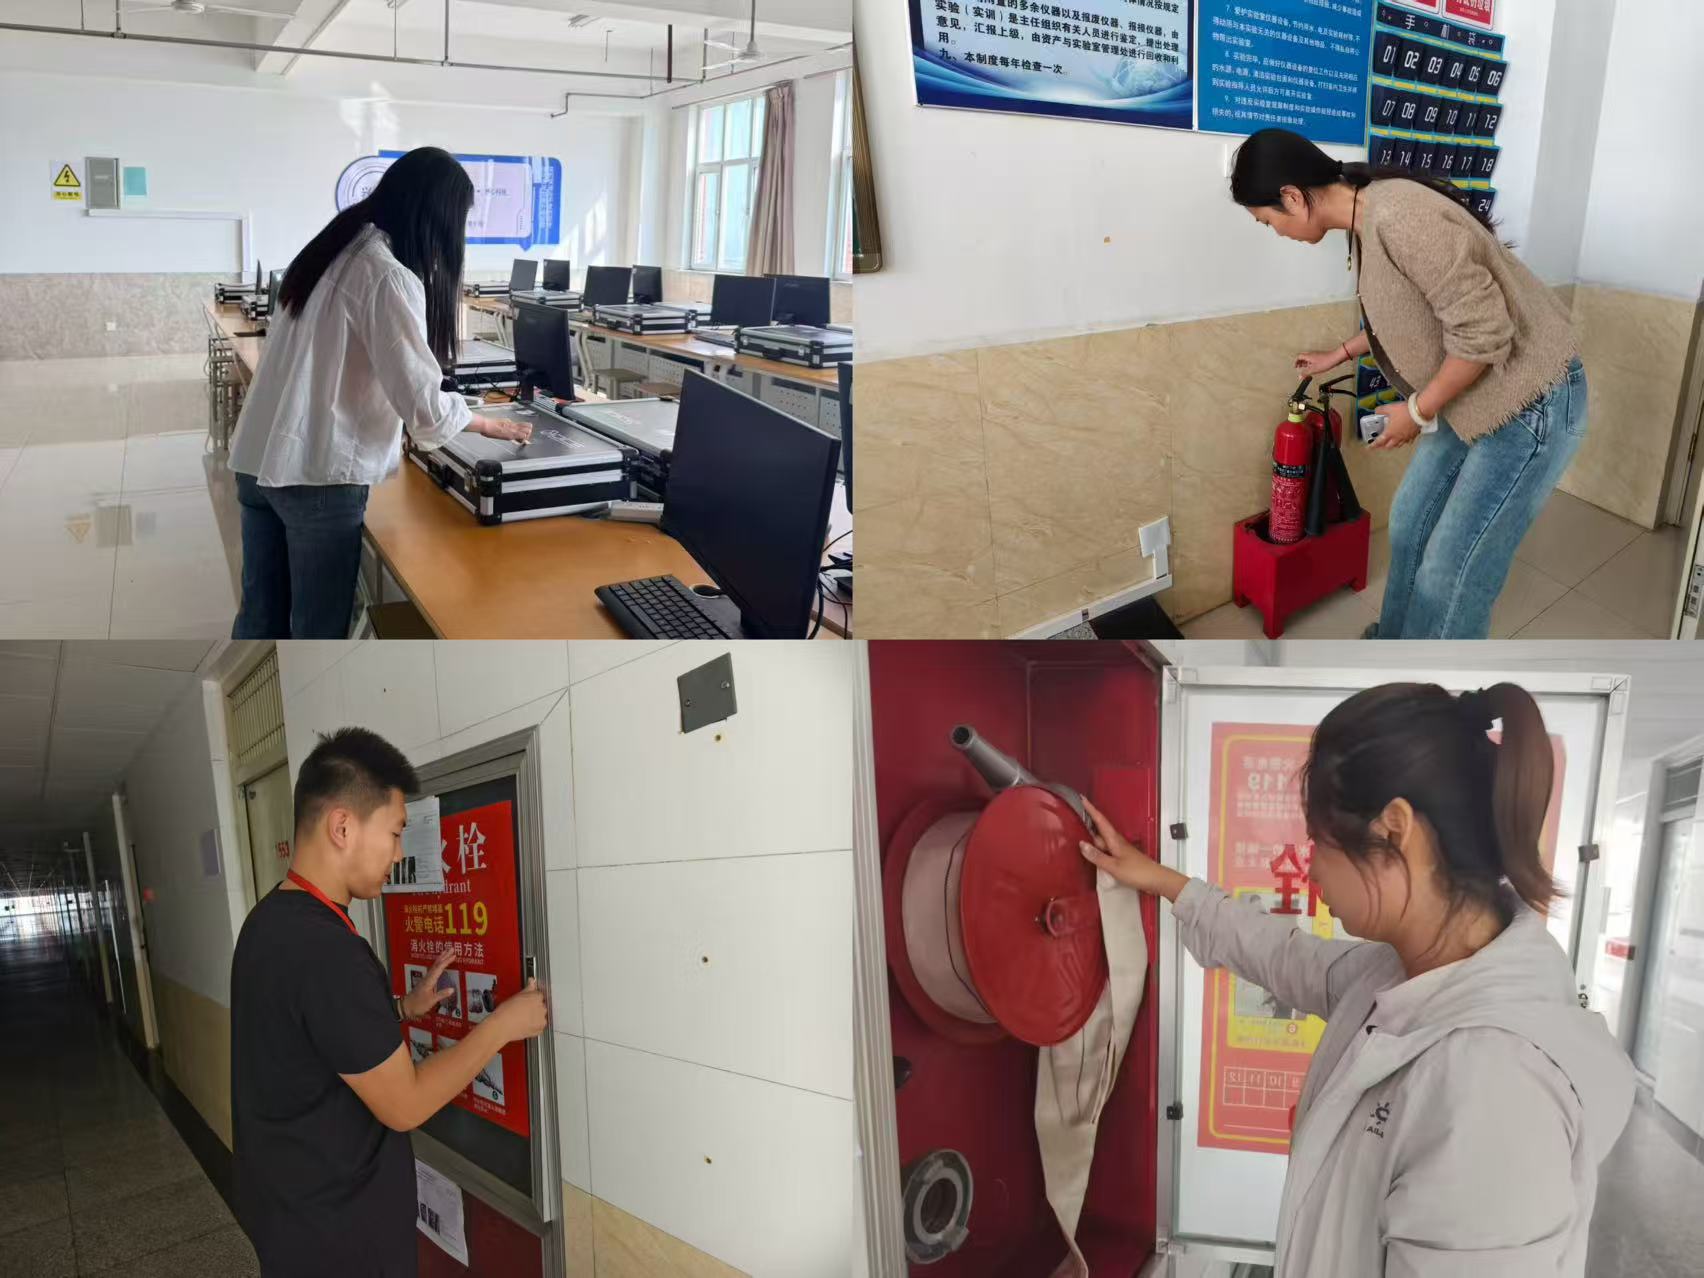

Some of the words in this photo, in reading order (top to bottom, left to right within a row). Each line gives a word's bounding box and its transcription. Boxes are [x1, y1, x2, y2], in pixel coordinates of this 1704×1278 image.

[1124, 0, 1179, 13] 情况按规定
[939, 48, 1068, 75] 九、本制度每年检查一次。
[1383, 45, 1397, 64] 01
[1404, 51, 1420, 69] 02
[1428, 57, 1443, 74] 03
[1450, 62, 1464, 79] 04
[1468, 66, 1480, 82] 05
[1487, 70, 1502, 86] 06
[1382, 100, 1396, 117] 07
[1401, 102, 1416, 119] 08
[1425, 106, 1438, 122] 09
[1446, 109, 1458, 125] 10
[1466, 112, 1477, 127] 11
[1484, 114, 1497, 129] 12
[1380, 149, 1391, 165] 13
[1399, 151, 1411, 166] 14
[1421, 153, 1432, 168] 15
[1441, 154, 1453, 169] 16
[1461, 156, 1472, 170] 17
[1481, 158, 1494, 172] 18
[1478, 199, 1491, 212] 24
[405, 916, 444, 934] 火警电话
[444, 900, 489, 936] 119
[410, 938, 485, 958] 消火栓的使用方法
